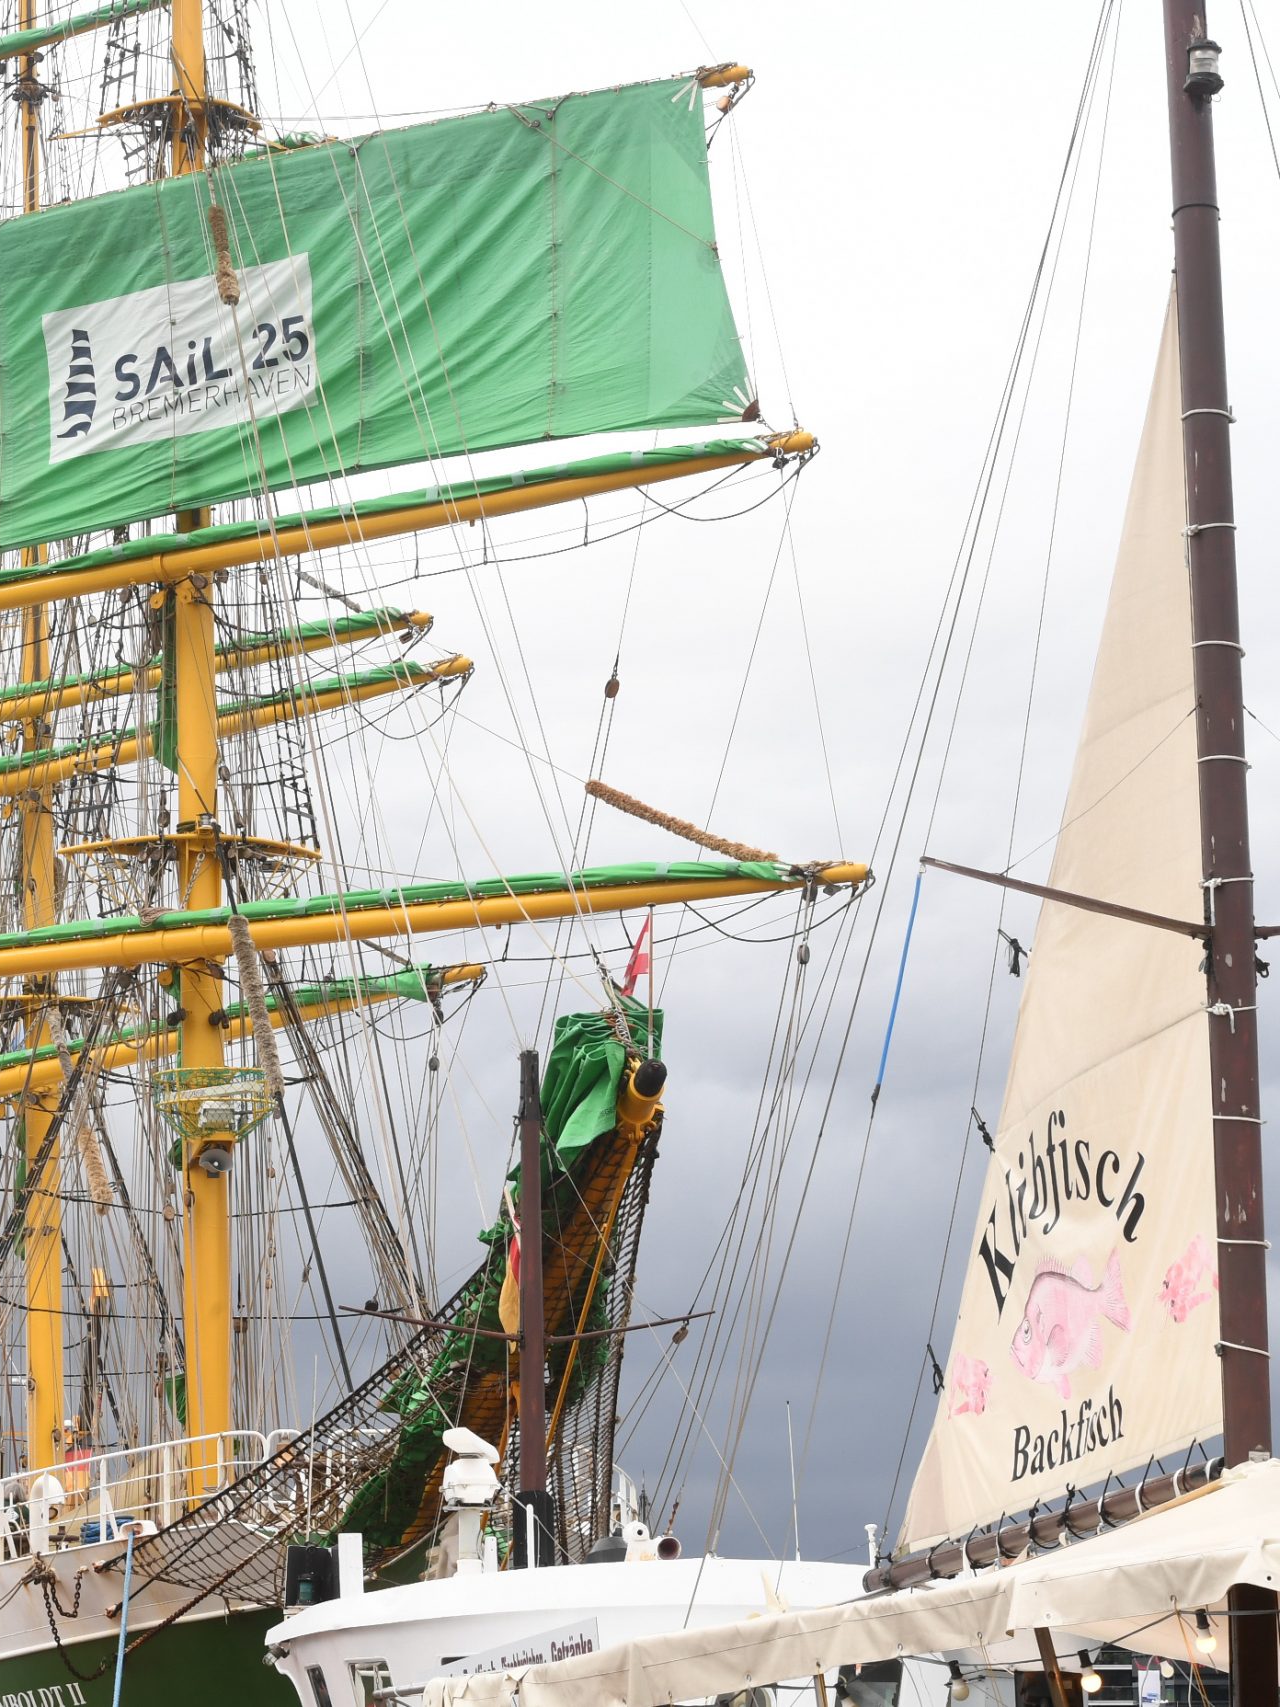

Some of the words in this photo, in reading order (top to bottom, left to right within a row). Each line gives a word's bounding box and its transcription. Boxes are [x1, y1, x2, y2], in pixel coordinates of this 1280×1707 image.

[251, 315, 310, 370] 25
[112, 364, 311, 431] BREMERHAVEN
[977, 1109, 1145, 1326] Klibfisch
[1009, 1383, 1124, 1482] Backfisch
